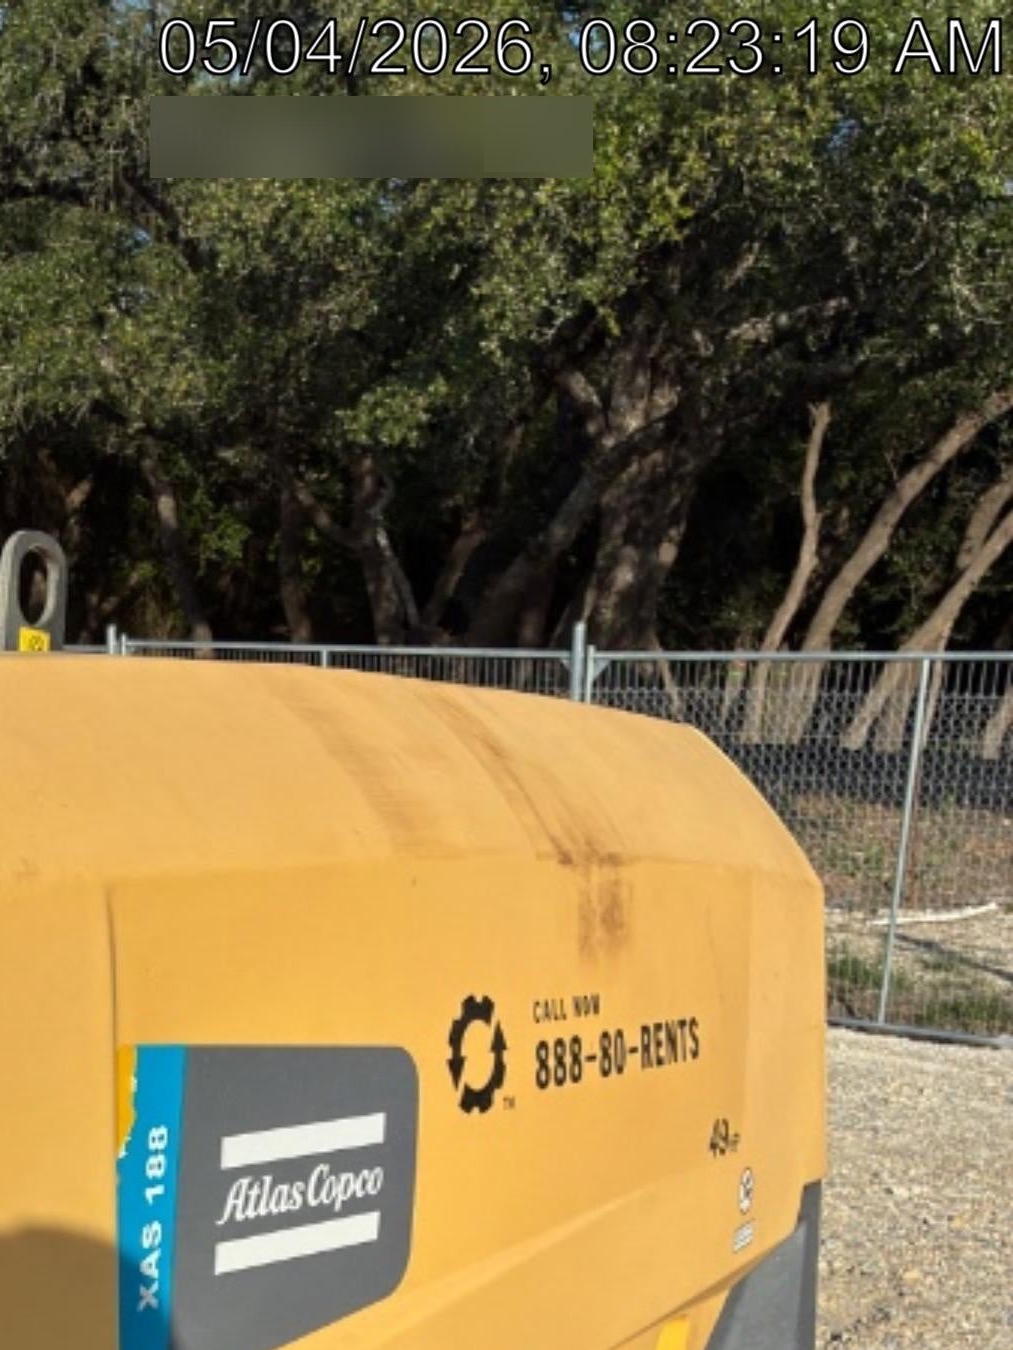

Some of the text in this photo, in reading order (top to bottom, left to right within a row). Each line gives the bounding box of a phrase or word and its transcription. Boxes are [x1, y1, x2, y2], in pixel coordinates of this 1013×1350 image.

[533, 993, 601, 1023] CALL NOW
[535, 1016, 700, 1090] 888-80-RENTS
[138, 1125, 168, 1312] XAS 188
